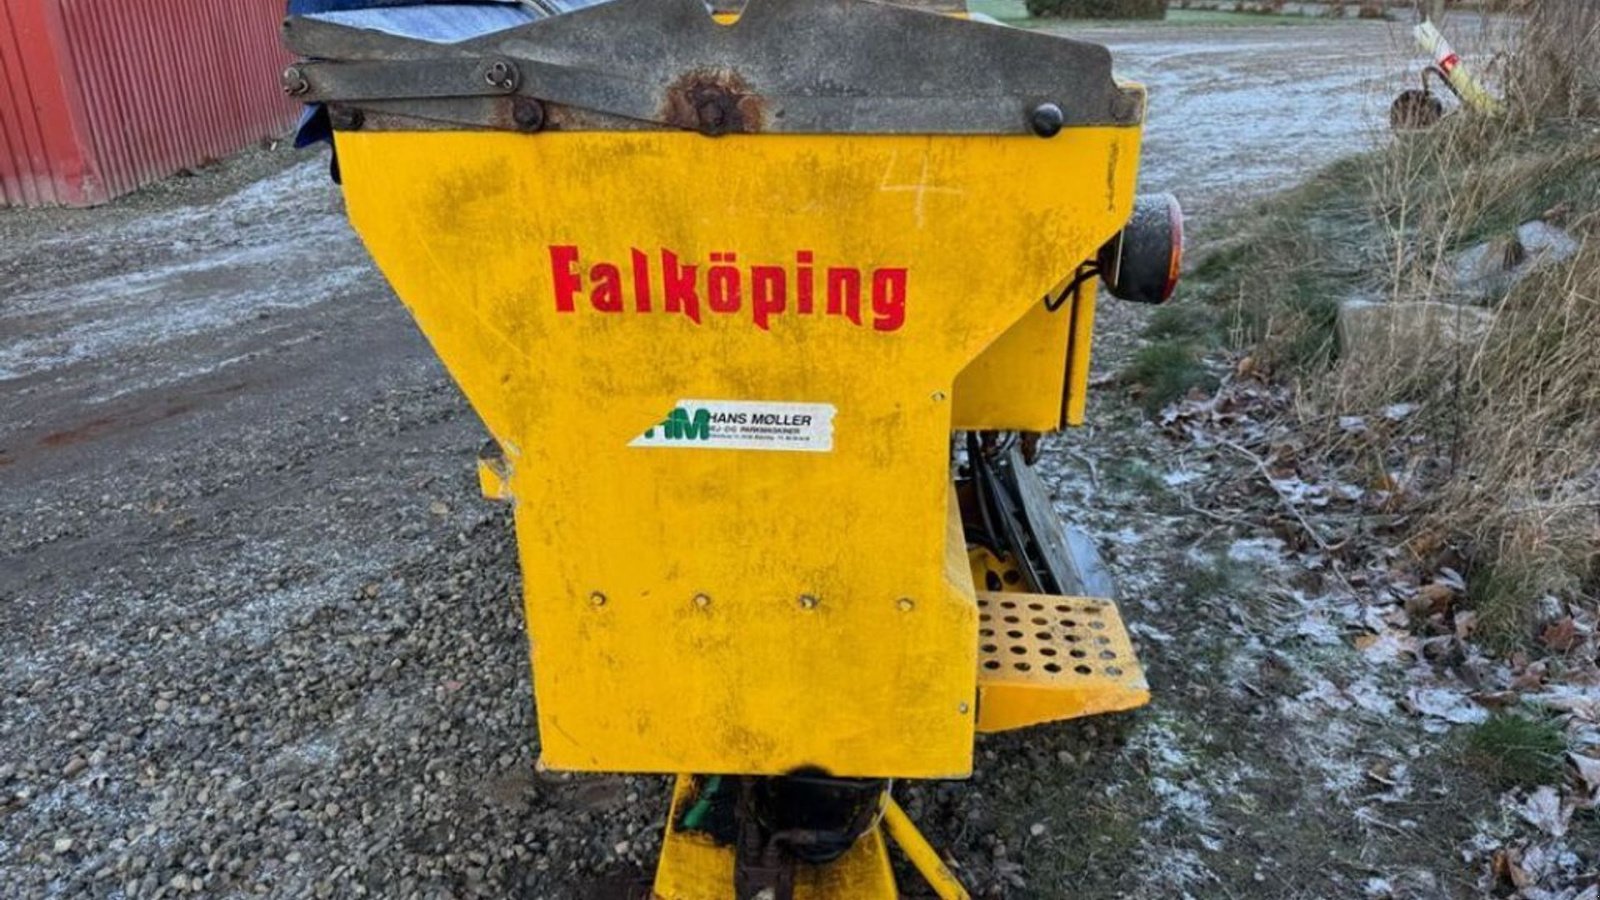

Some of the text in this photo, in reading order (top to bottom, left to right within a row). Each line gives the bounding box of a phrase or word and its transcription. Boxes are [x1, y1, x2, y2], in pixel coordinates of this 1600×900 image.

[879, 147, 965, 229] 4
[549, 245, 909, 331] Falköping
[708, 412, 812, 426] HANS MØLLER
